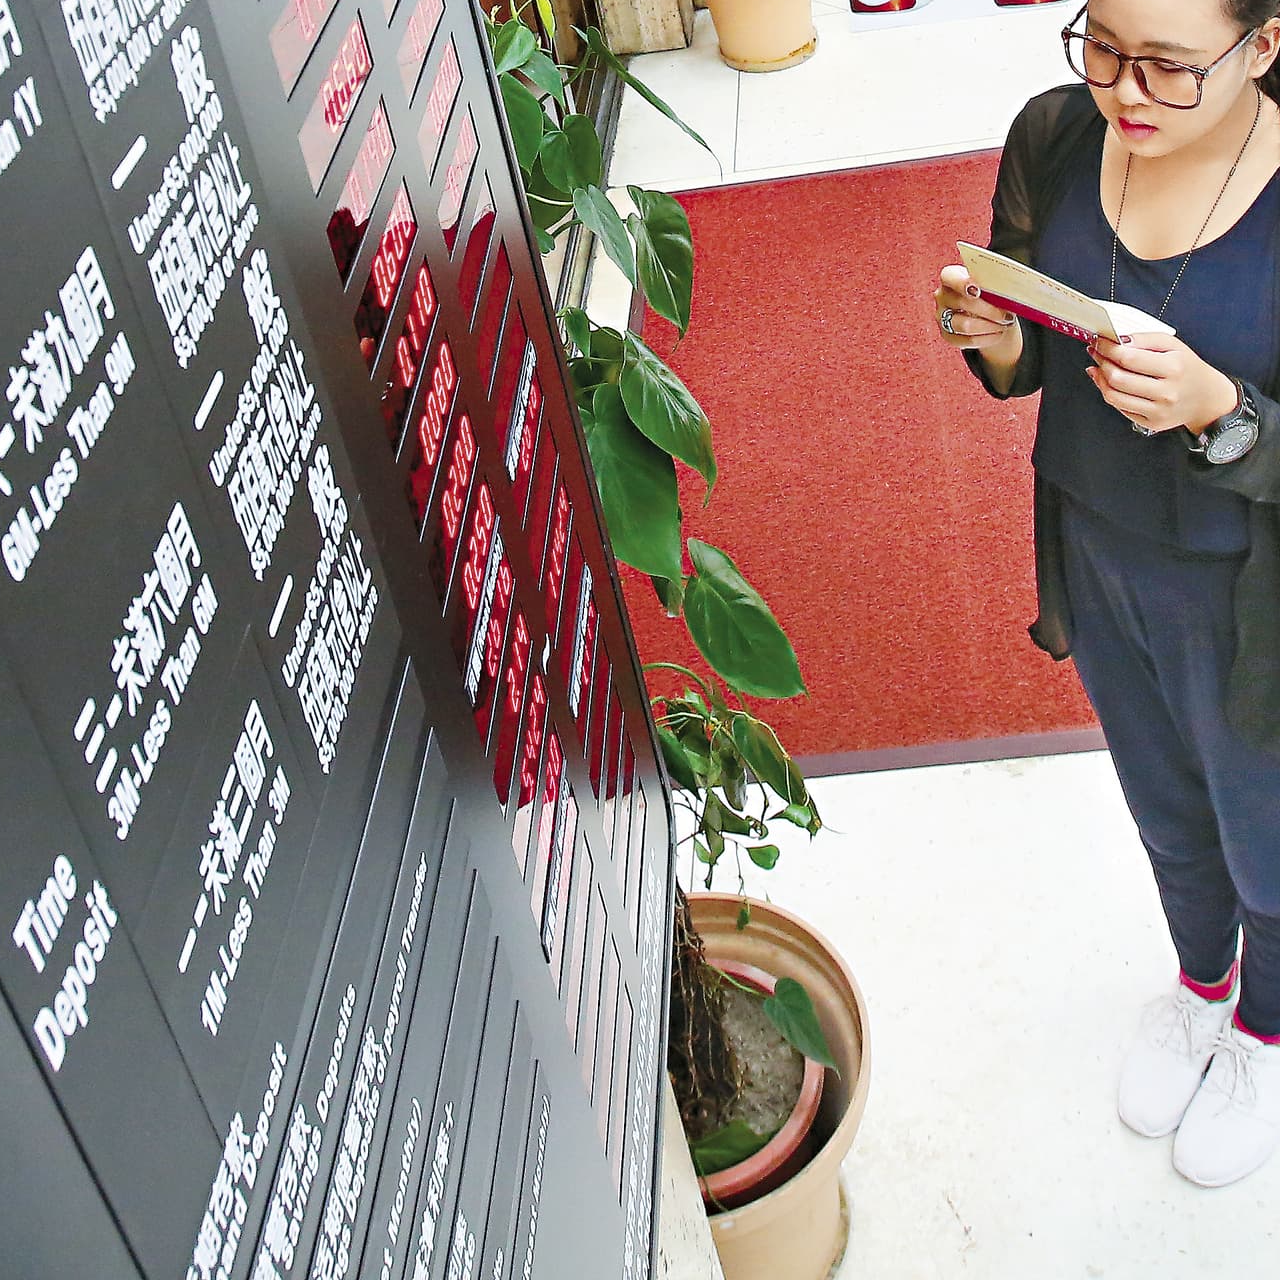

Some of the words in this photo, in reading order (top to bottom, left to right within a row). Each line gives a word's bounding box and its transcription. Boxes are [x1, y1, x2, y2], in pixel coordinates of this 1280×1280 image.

[13, 75, 43, 137] 1Y
[66, 380, 115, 459] Than
[159, 626, 203, 705] Than
[243, 820, 277, 900] Than
[12, 853, 79, 974] Time
[32, 878, 120, 1074] Deposit
[243, 1041, 287, 1190] Deposit
[282, 1126, 322, 1271] Savings
[316, 983, 357, 1124] Deposits
